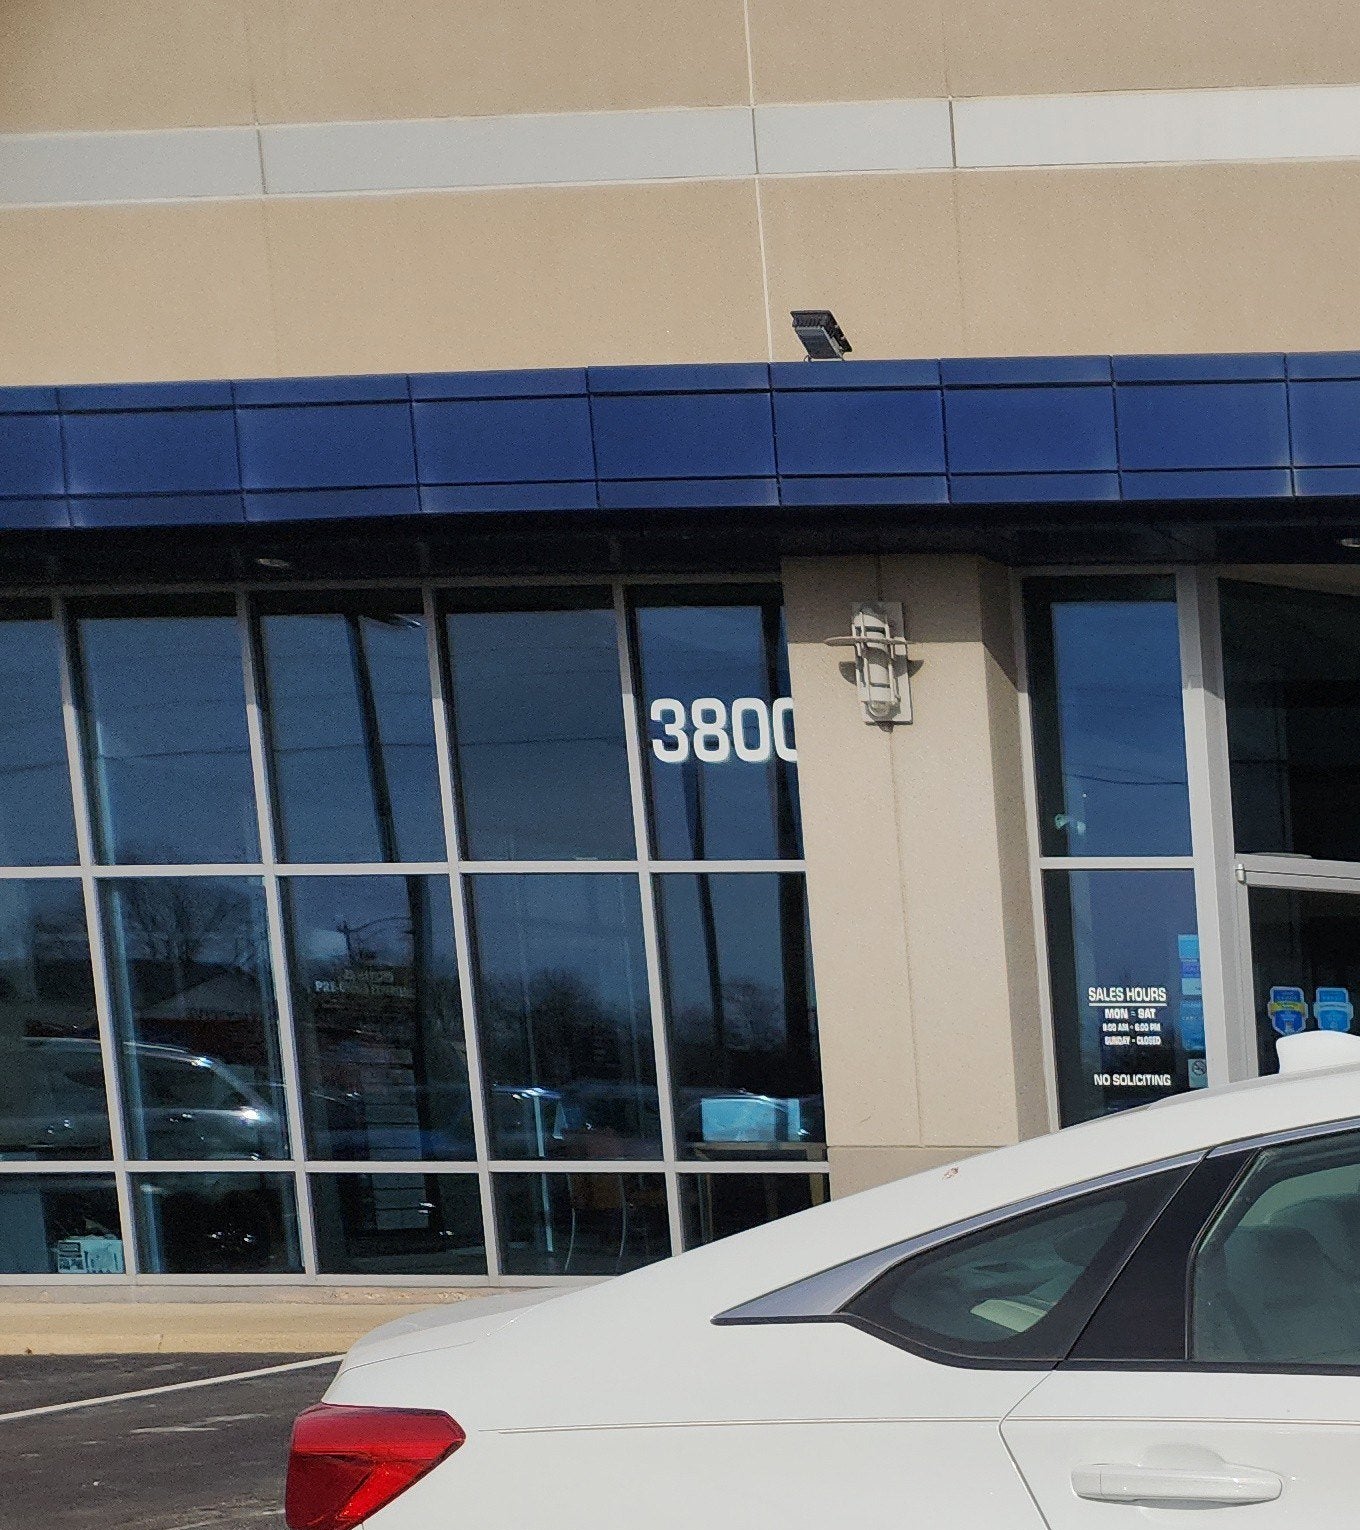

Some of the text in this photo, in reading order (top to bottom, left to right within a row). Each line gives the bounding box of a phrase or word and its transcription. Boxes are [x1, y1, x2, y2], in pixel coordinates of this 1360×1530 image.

[650, 697, 798, 763] 3800
[1088, 986, 1167, 1002] SALES HOURS
[1104, 1008, 1128, 1020] MON
[1093, 1073, 1172, 1086] NO SOLICITING
